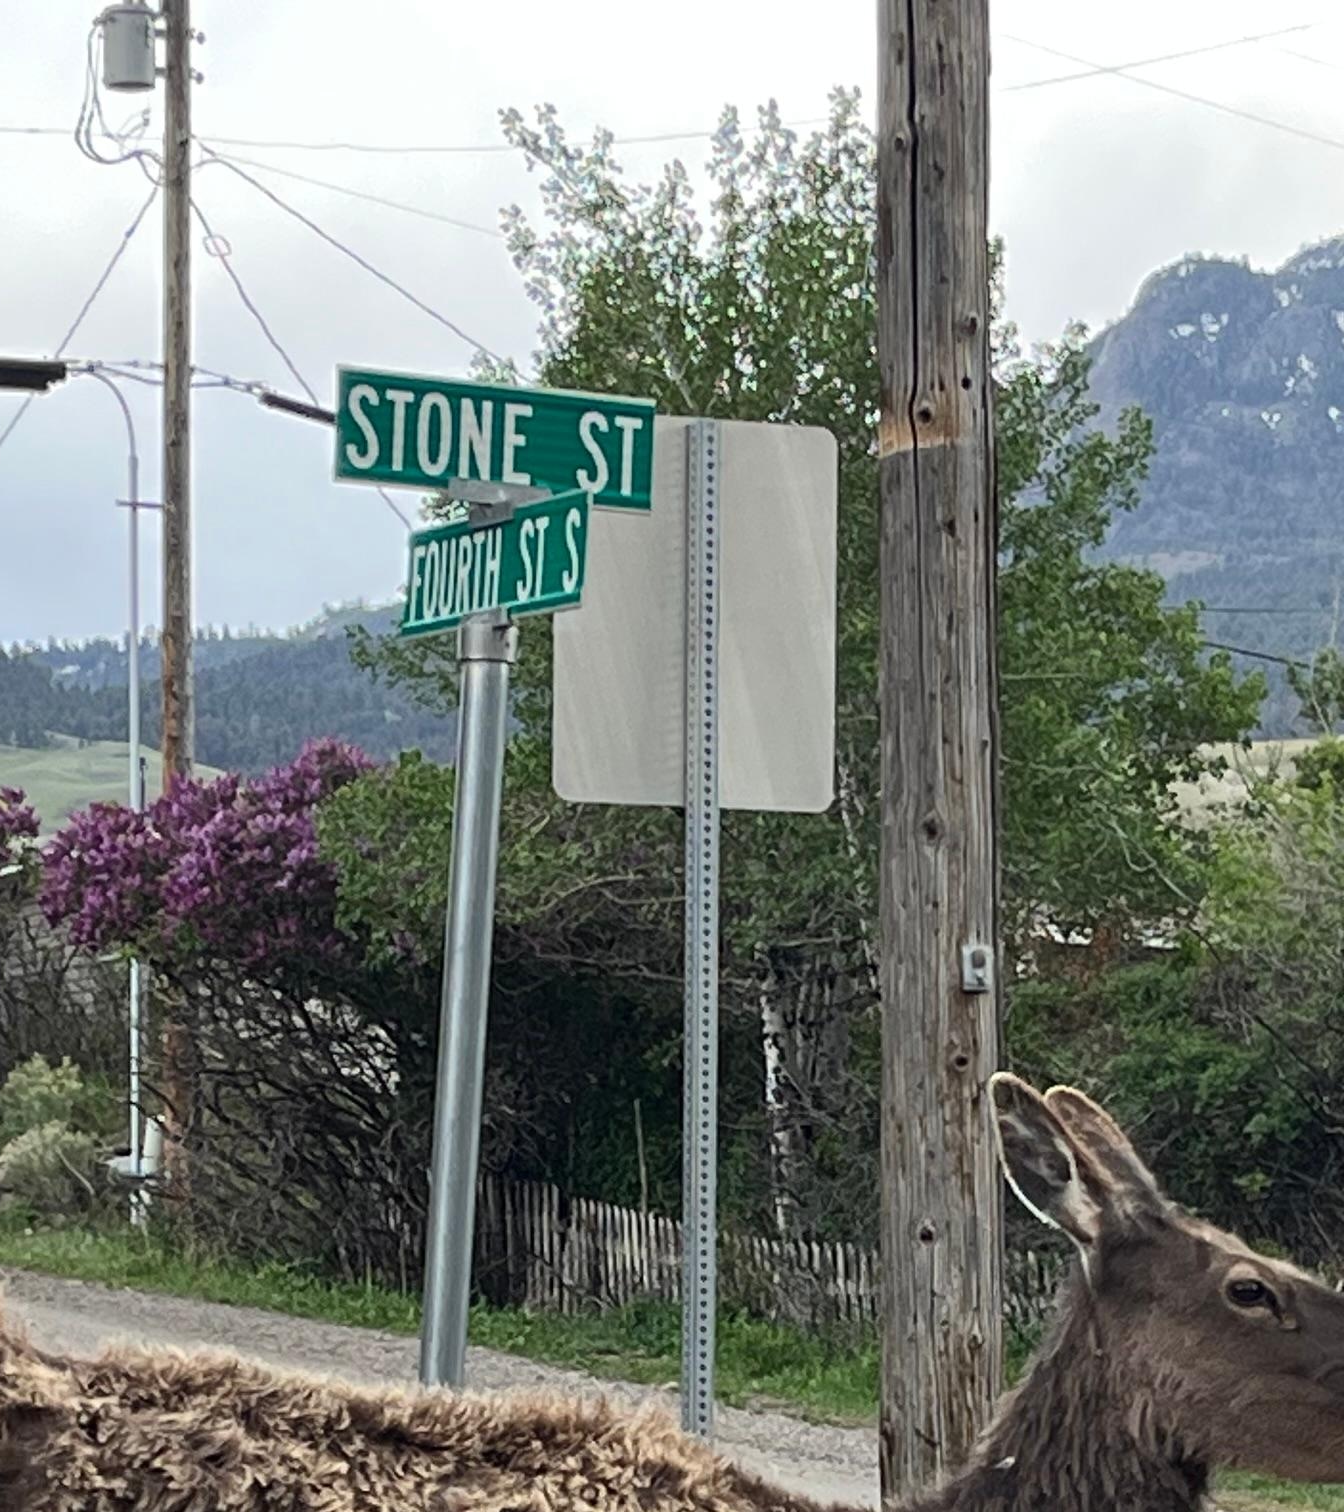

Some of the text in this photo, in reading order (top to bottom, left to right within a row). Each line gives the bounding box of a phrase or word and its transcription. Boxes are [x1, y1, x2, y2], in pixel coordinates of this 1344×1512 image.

[345, 384, 644, 497] STONE ST
[408, 507, 582, 625] FOURTH ST S
